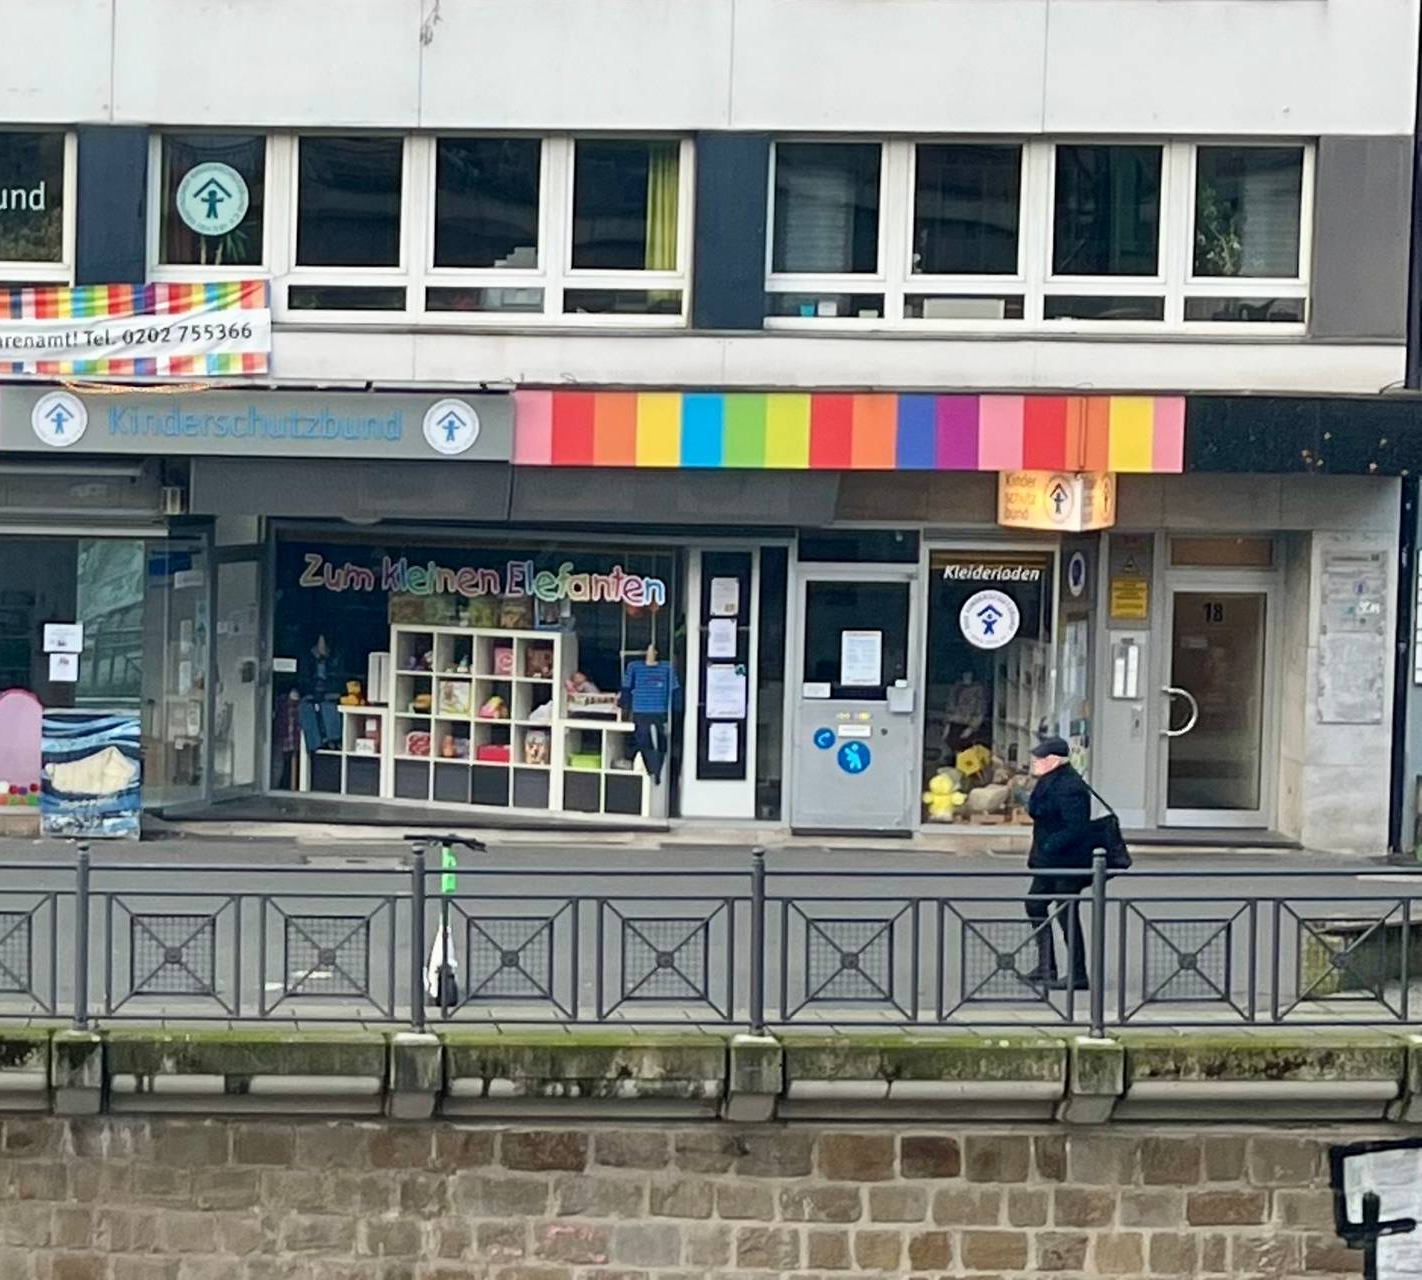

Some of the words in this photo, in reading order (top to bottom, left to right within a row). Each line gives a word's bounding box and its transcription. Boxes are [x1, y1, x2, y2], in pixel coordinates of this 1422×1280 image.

[84, 330, 116, 347] Tel.
[122, 325, 171, 345] 0202
[178, 322, 253, 342] 755366
[107, 405, 404, 441] Kinderschutzbund
[298, 552, 375, 593] Zum
[380, 556, 500, 599] kleinen
[504, 560, 666, 607] Elefanten
[943, 564, 1040, 581] Kleiderladen
[1202, 602, 1224, 623] 18
